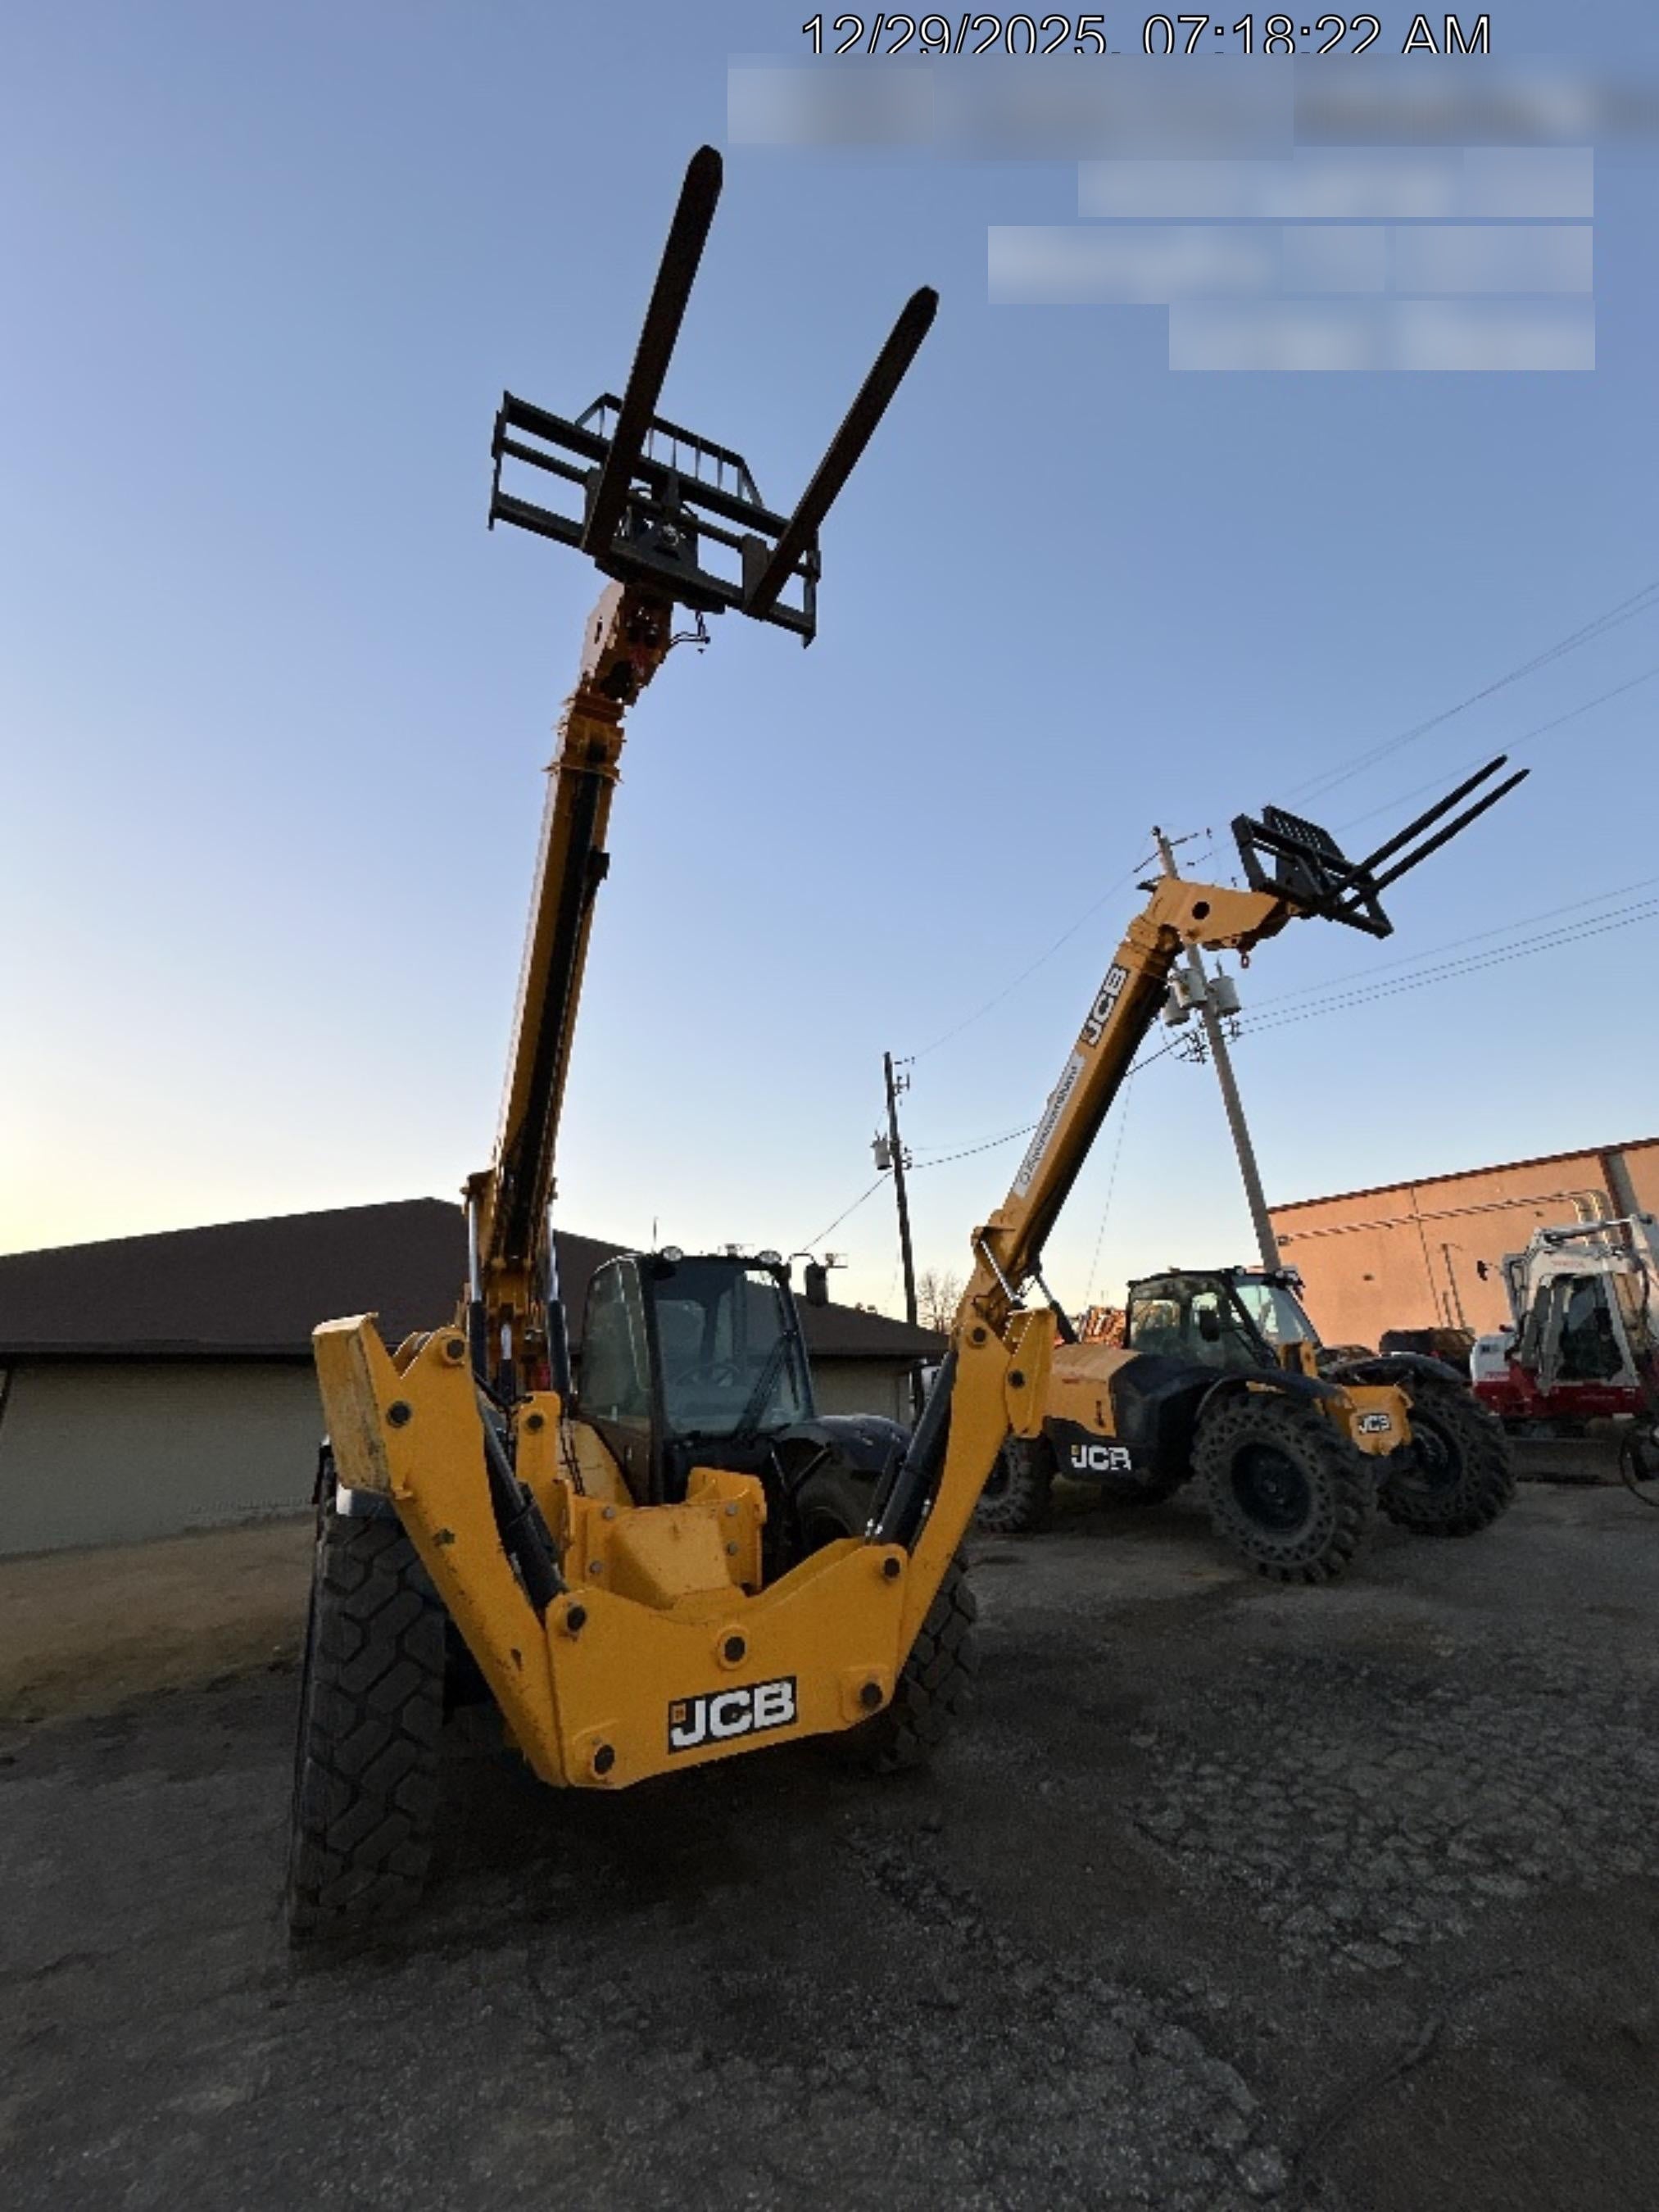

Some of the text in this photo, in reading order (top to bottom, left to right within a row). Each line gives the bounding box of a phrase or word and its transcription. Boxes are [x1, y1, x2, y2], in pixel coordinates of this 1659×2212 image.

[1086, 966, 1130, 1046] JCB
[1358, 1414, 1390, 1434] JCB
[1070, 1444, 1132, 1471] JCB
[670, 1680, 796, 1747] JCB
